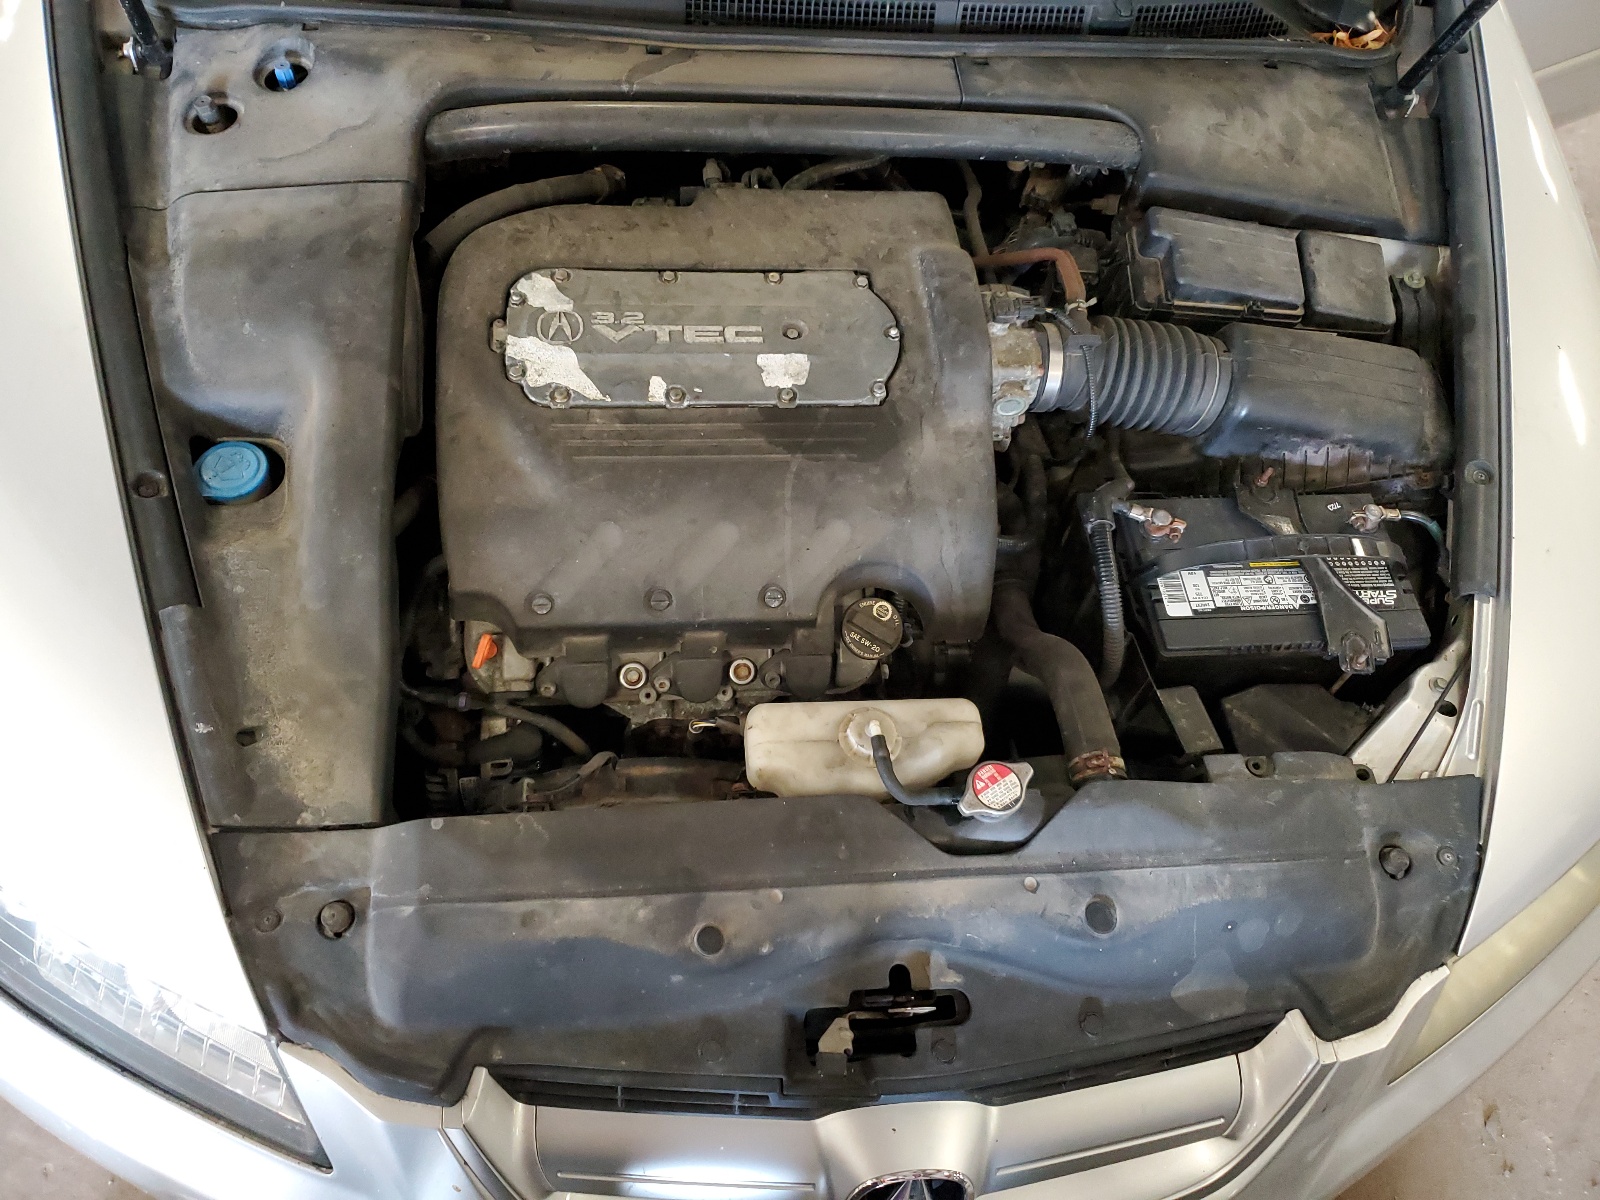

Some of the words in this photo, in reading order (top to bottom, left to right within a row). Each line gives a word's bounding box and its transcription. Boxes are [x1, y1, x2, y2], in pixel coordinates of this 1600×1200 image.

[591, 311, 645, 324] 3.2
[592, 325, 764, 344] VTEC
[850, 631, 861, 642] SAE
[860, 637, 881, 653] 5W-20
